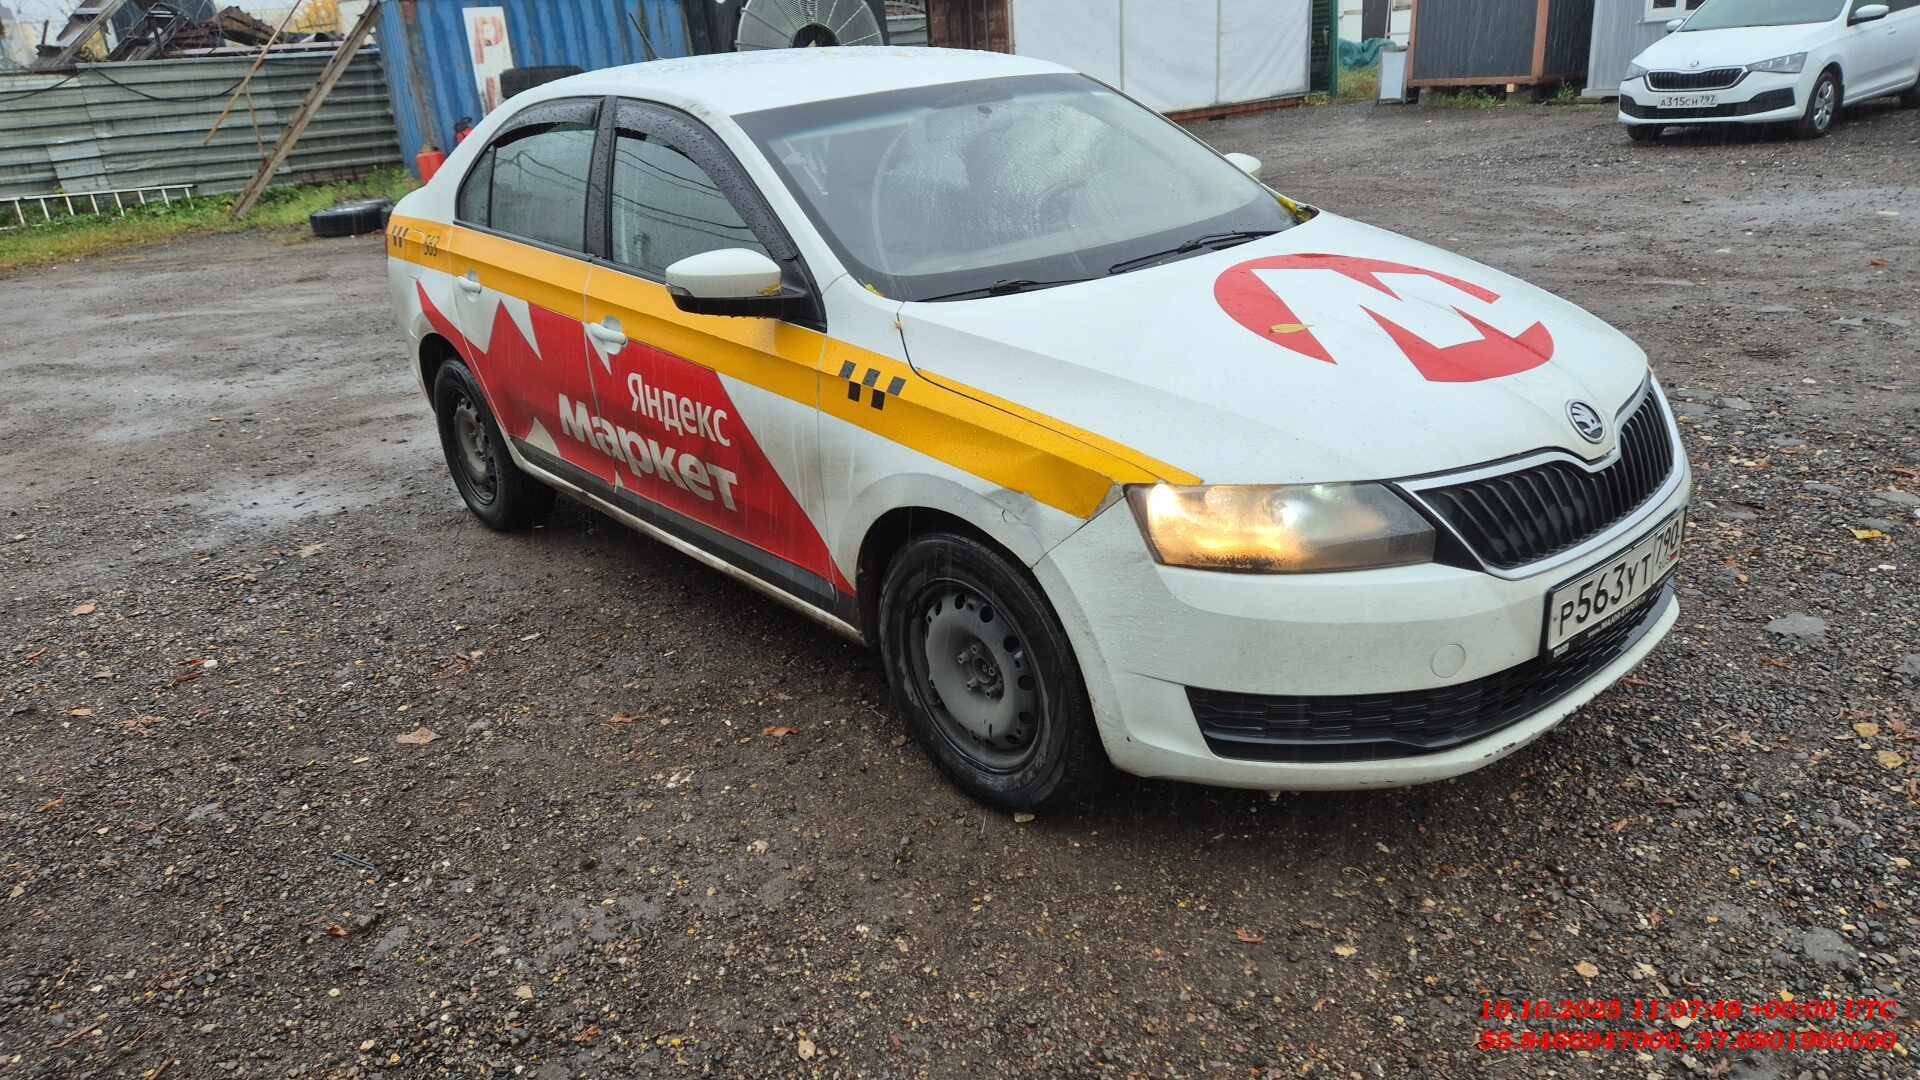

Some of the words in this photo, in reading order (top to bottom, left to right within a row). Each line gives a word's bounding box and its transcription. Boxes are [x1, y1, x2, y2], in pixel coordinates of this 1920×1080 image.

[627, 372, 731, 447] Яндекс
[1559, 553, 1652, 637] Р563УТ
[1656, 519, 1679, 564] 790
